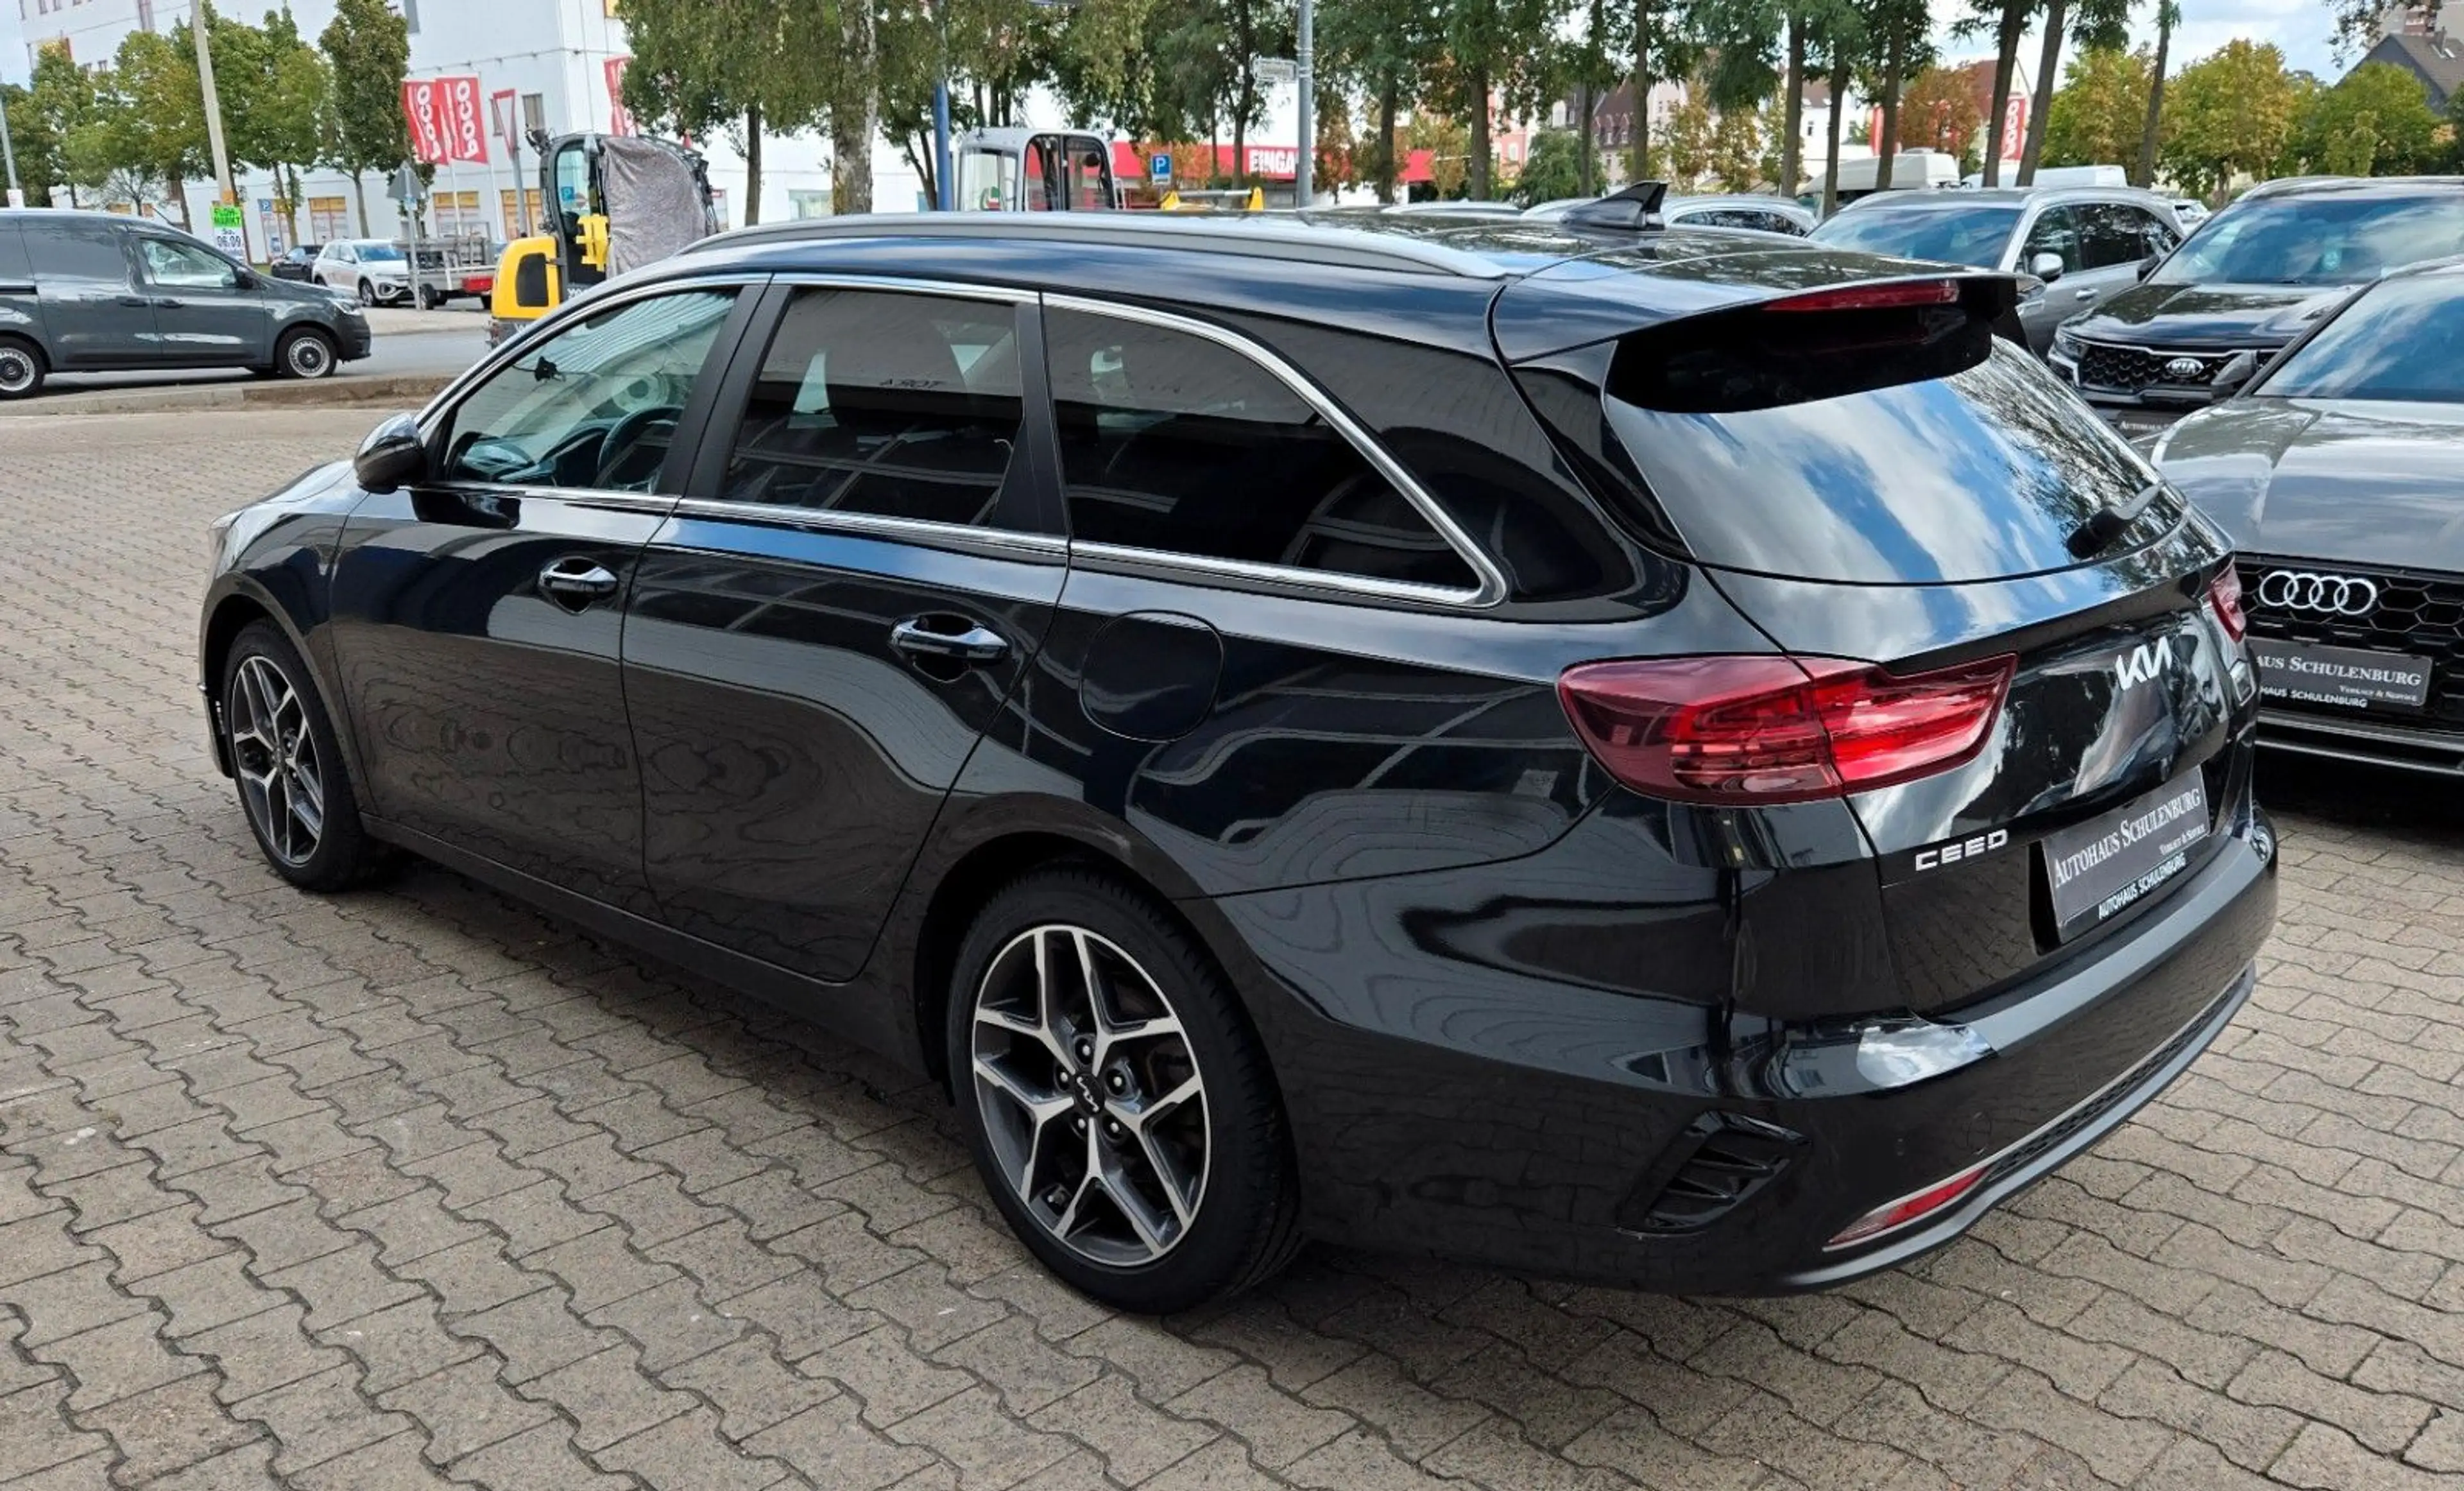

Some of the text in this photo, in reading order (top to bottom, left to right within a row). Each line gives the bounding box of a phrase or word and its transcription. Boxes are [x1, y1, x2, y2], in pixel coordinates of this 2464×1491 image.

[417, 85, 441, 160] poco
[457, 80, 479, 159] poco
[1156, 157, 1167, 172] P
[2288, 656, 2422, 686] SCHULENBURG
[2291, 691, 2368, 709] SCHULENBURG
[1915, 829, 2008, 871] CEED
[2055, 831, 2121, 888] AUTOHAUS
[2120, 788, 2200, 849] SCHULENBURG
[2099, 852, 2187, 920] AUTOHAUS SCHULENBURG
